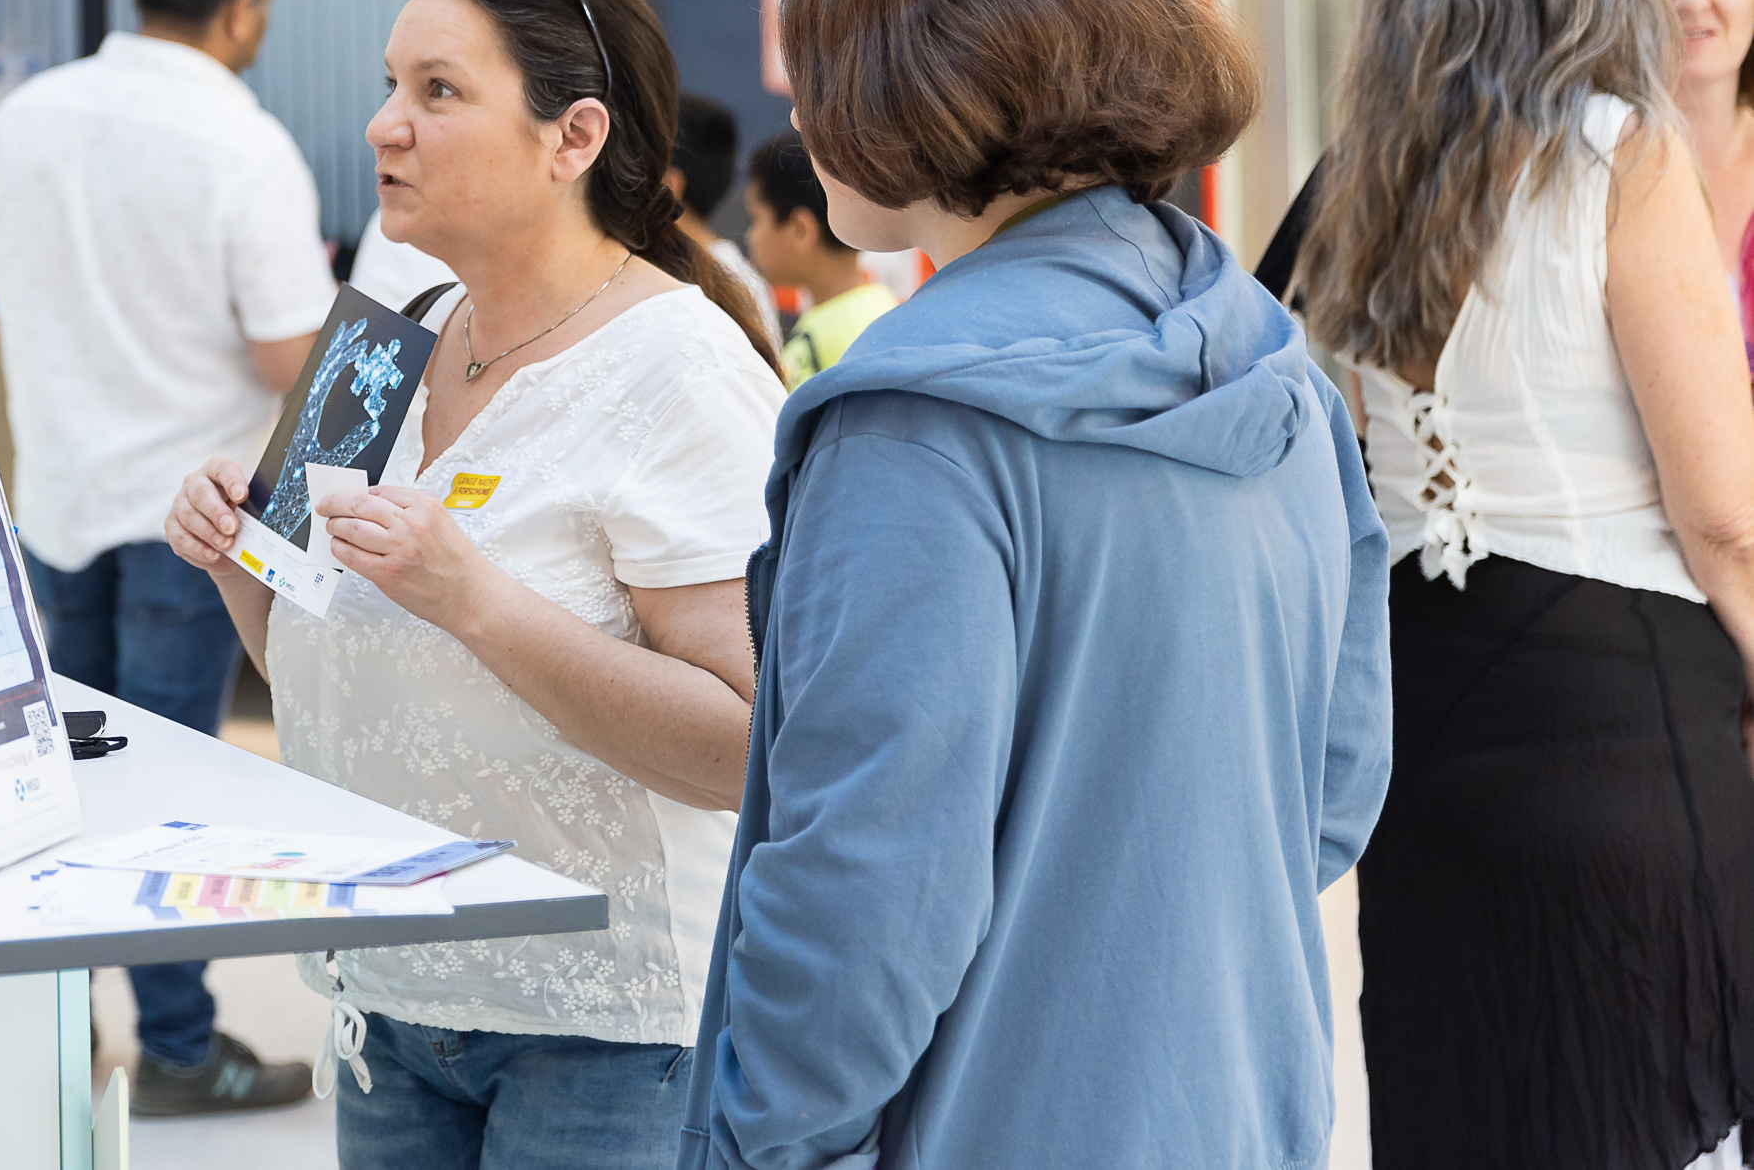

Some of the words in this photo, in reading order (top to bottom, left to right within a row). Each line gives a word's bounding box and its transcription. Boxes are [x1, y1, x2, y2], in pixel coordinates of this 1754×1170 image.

[457, 476, 478, 486] LANGE
[479, 478, 497, 487] NACHT
[458, 486, 492, 496] FORSCHUNG
